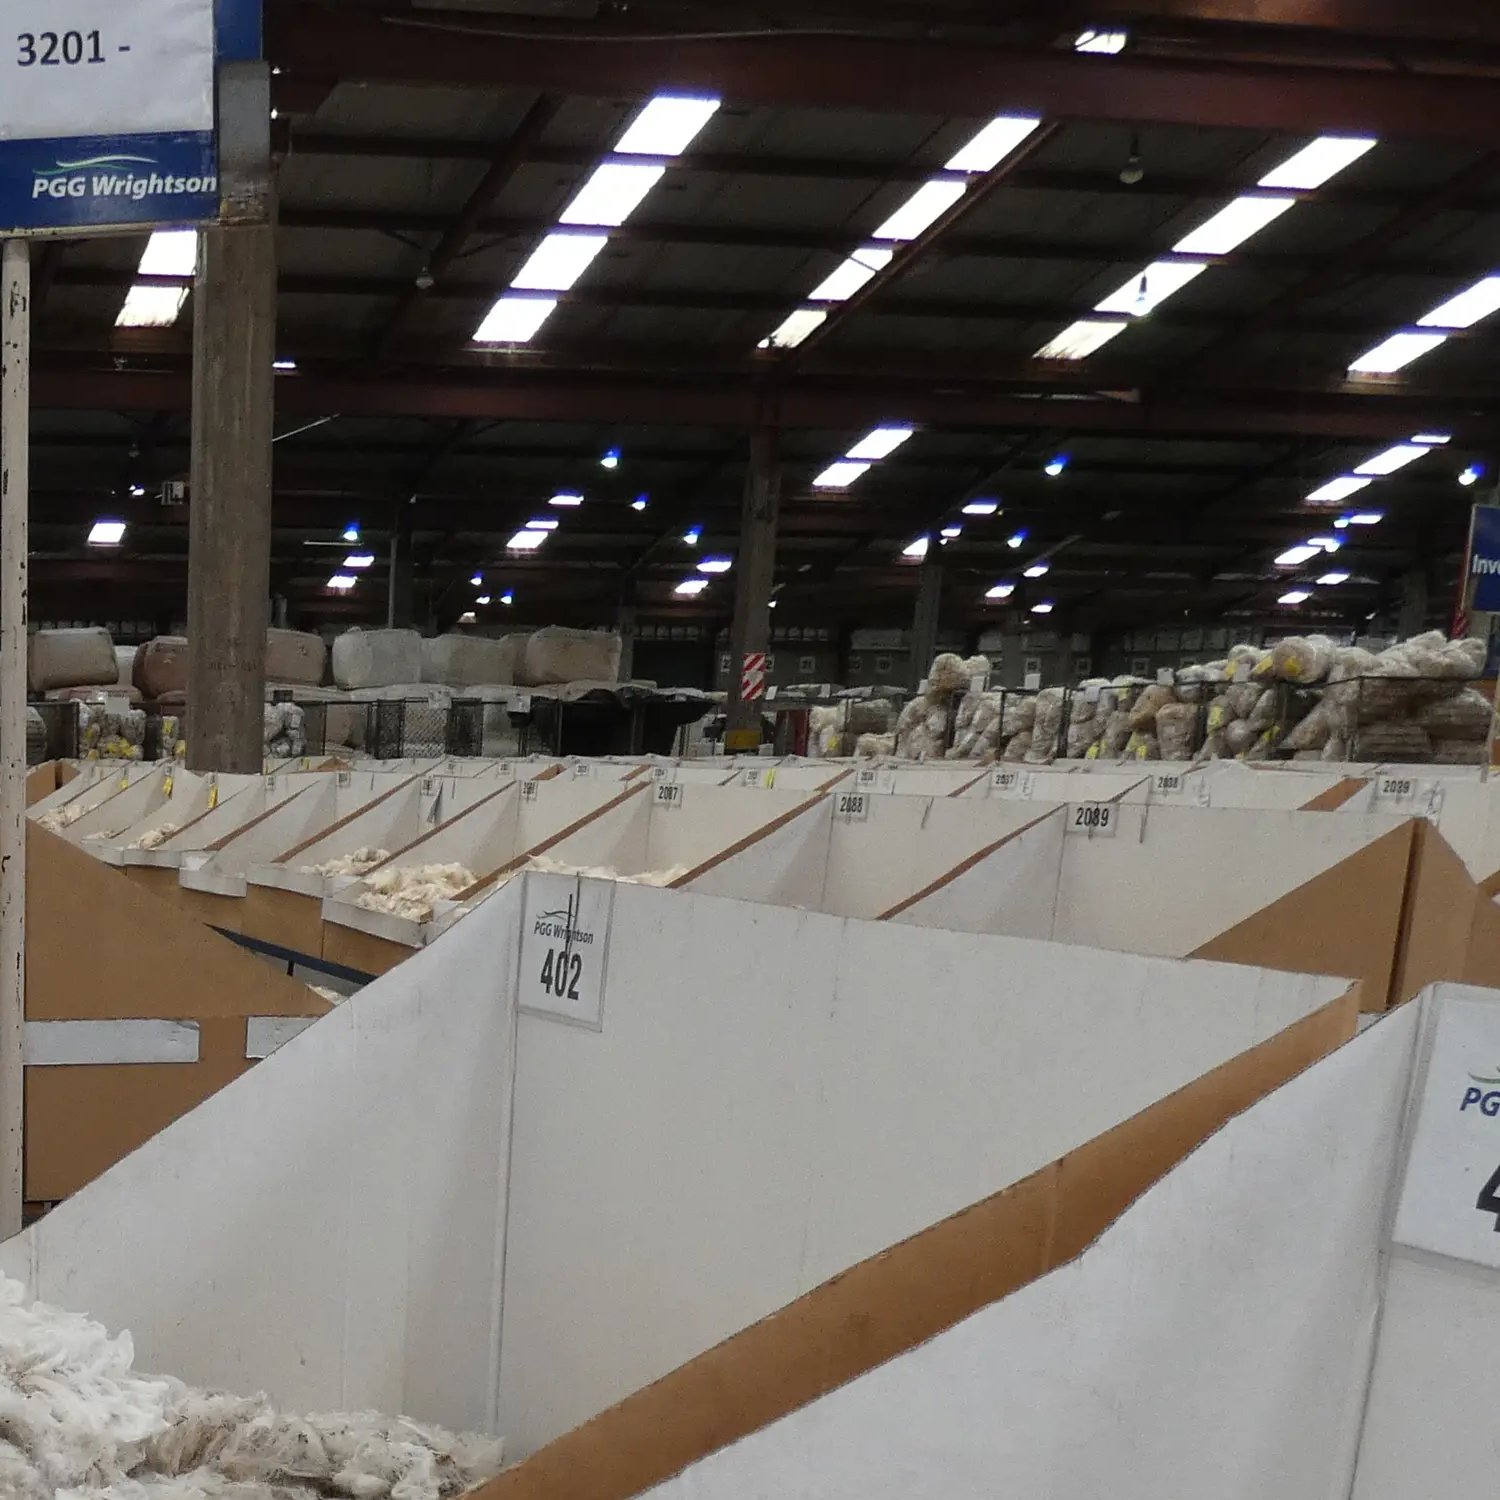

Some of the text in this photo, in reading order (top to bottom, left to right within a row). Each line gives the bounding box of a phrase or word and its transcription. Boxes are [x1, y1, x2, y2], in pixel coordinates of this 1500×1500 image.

[17, 30, 105, 67] 3201
[32, 174, 217, 200] PGG Wrightson
[1383, 780, 1410, 793] 2039
[840, 796, 863, 813] 2088
[1075, 807, 1109, 827] 2089
[534, 921, 552, 936] PGG
[540, 948, 582, 1001] 402
